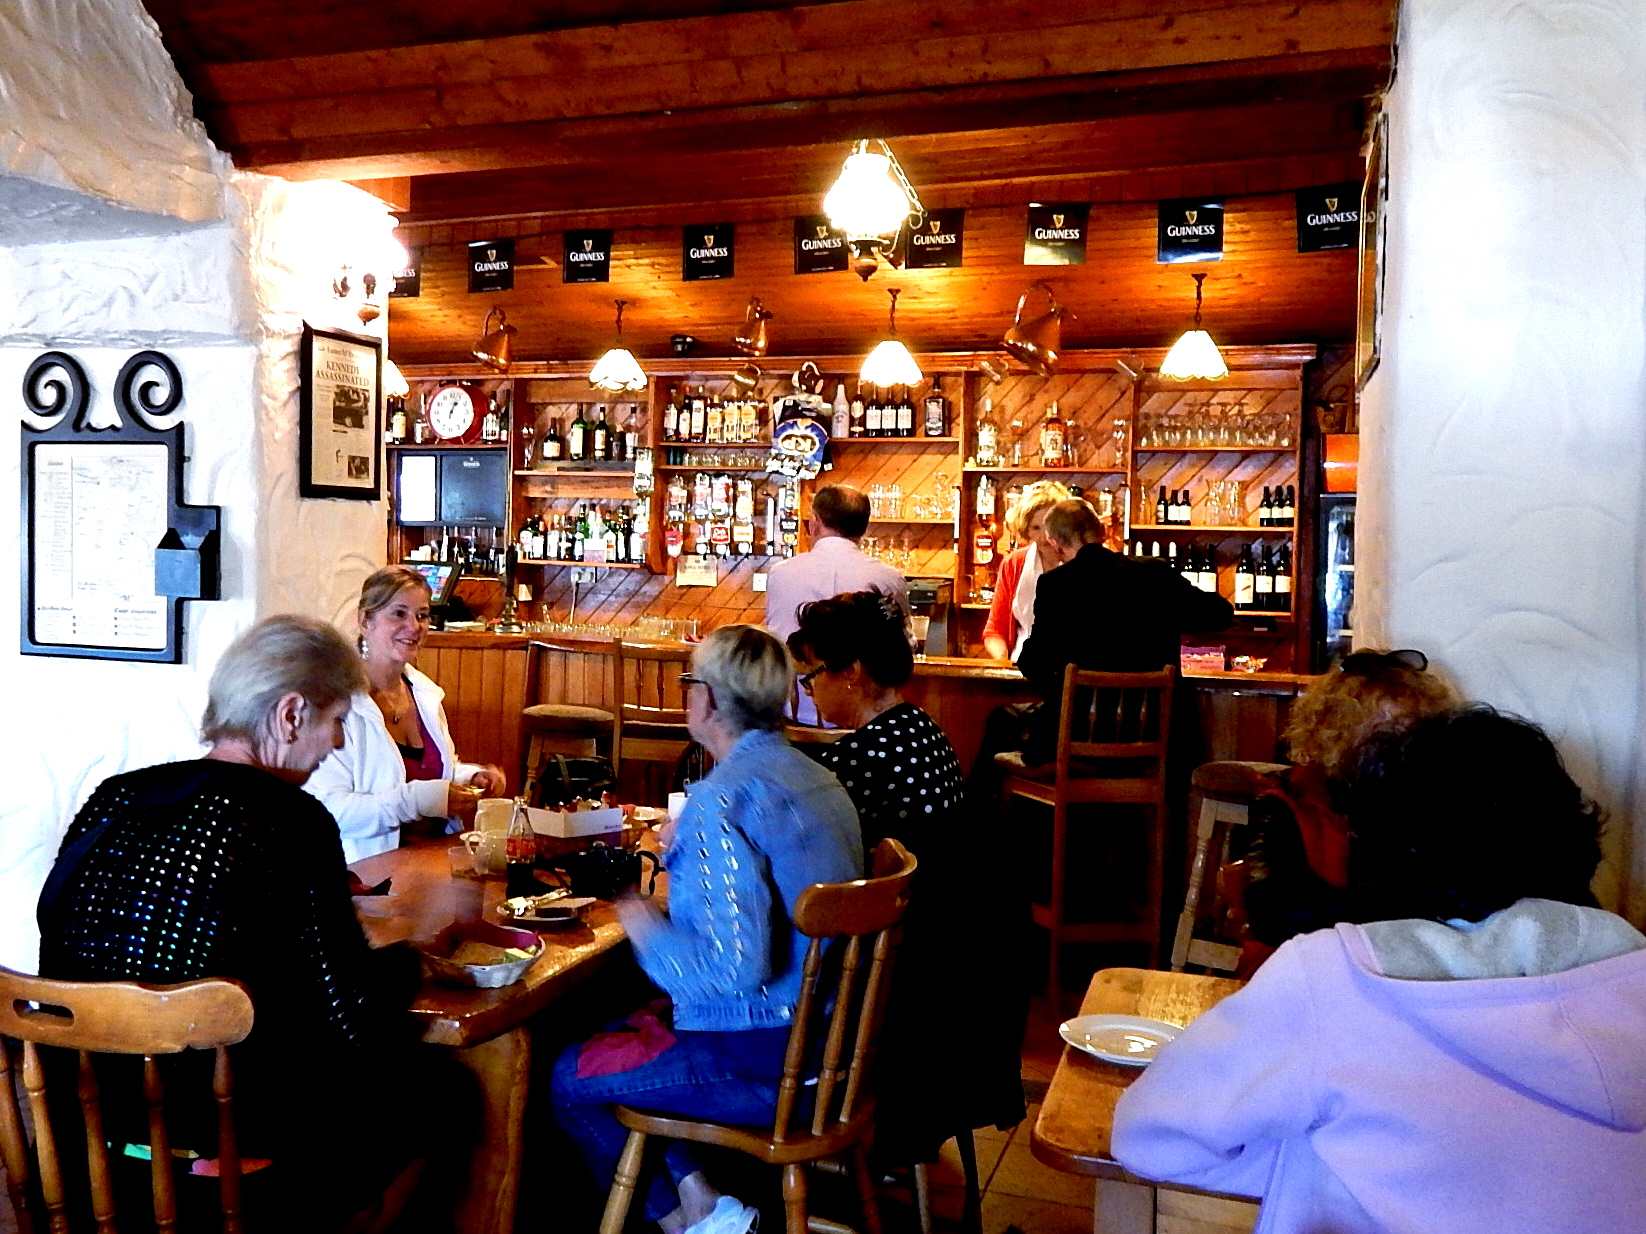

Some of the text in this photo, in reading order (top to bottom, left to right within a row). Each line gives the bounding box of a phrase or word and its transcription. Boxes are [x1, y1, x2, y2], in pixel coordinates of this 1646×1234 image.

[1307, 211, 1358, 226] GUINNESS
[1034, 227, 1080, 240] GUINNESS
[1167, 224, 1216, 237] GUINNESS
[801, 238, 842, 251] GUINNESS
[913, 233, 957, 246] GUINNESS
[569, 251, 605, 262] GUINNESS
[689, 247, 728, 259] GUINNESS
[474, 261, 509, 273] GUINNESS
[326, 360, 361, 375] KENNEDY
[316, 370, 370, 387] ASSASSINATED
[781, 436, 812, 452] KP
